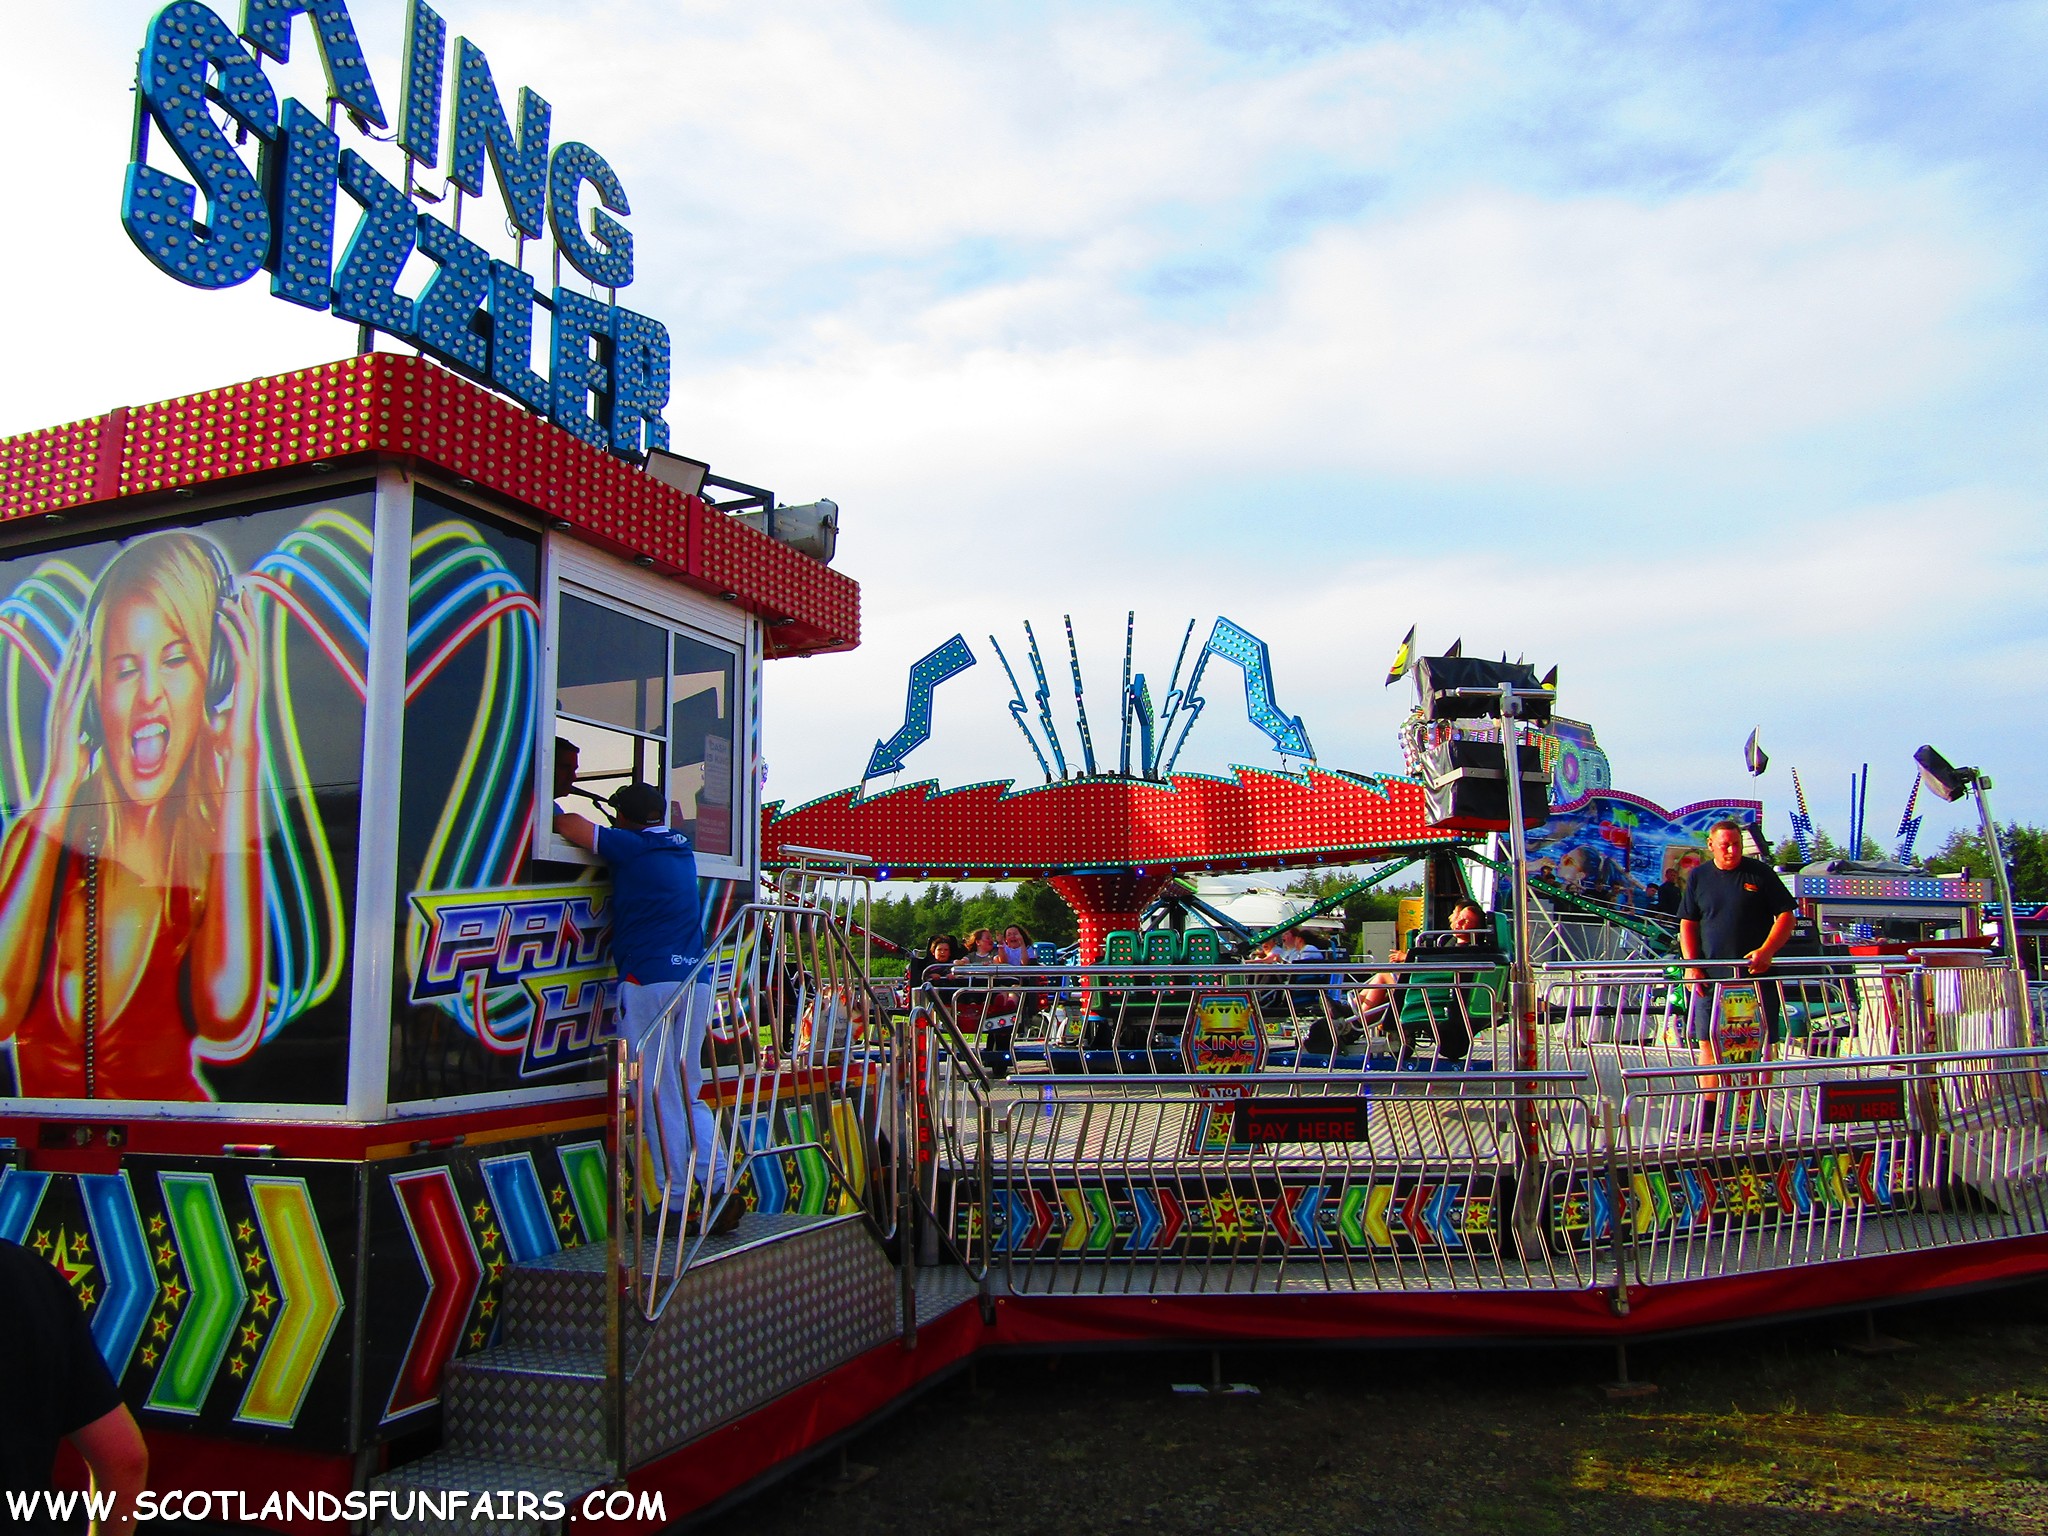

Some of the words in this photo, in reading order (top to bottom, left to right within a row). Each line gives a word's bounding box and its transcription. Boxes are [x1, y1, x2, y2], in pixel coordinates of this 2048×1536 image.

[121, 0, 671, 455] SIZZLER
[428, 900, 617, 982] PAY
[1193, 1034, 1256, 1051] KING
[1828, 1103, 1856, 1120] PAY
[1860, 1101, 1898, 1119] HERE
[1248, 1122, 1289, 1141] PAY
[1298, 1120, 1356, 1140] HERE
